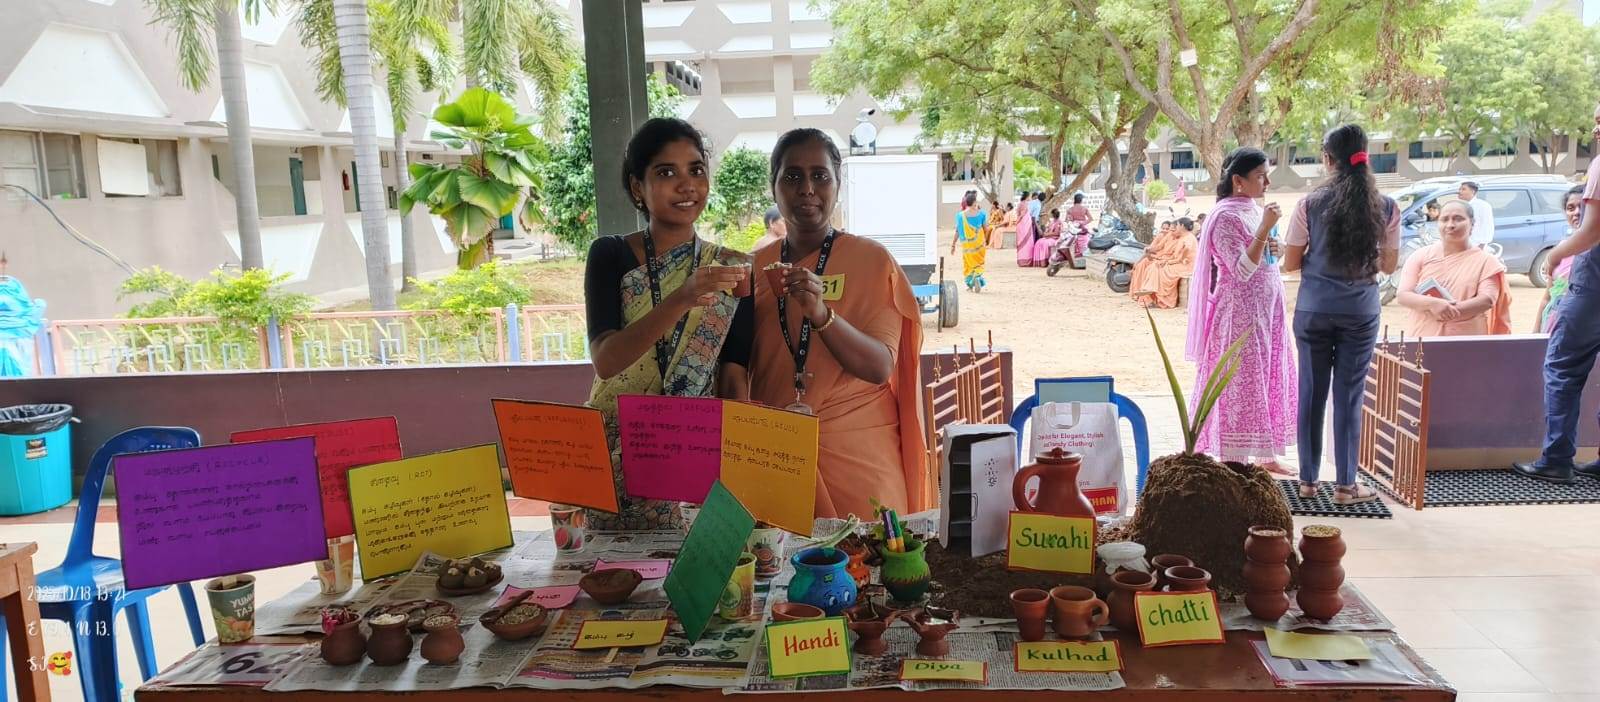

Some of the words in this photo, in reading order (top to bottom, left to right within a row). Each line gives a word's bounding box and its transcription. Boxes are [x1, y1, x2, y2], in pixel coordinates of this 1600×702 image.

[1015, 525, 1091, 550] Surahi
[783, 627, 841, 657] Handi
[1027, 646, 1111, 663] Kulhad
[914, 661, 964, 673] Diya
